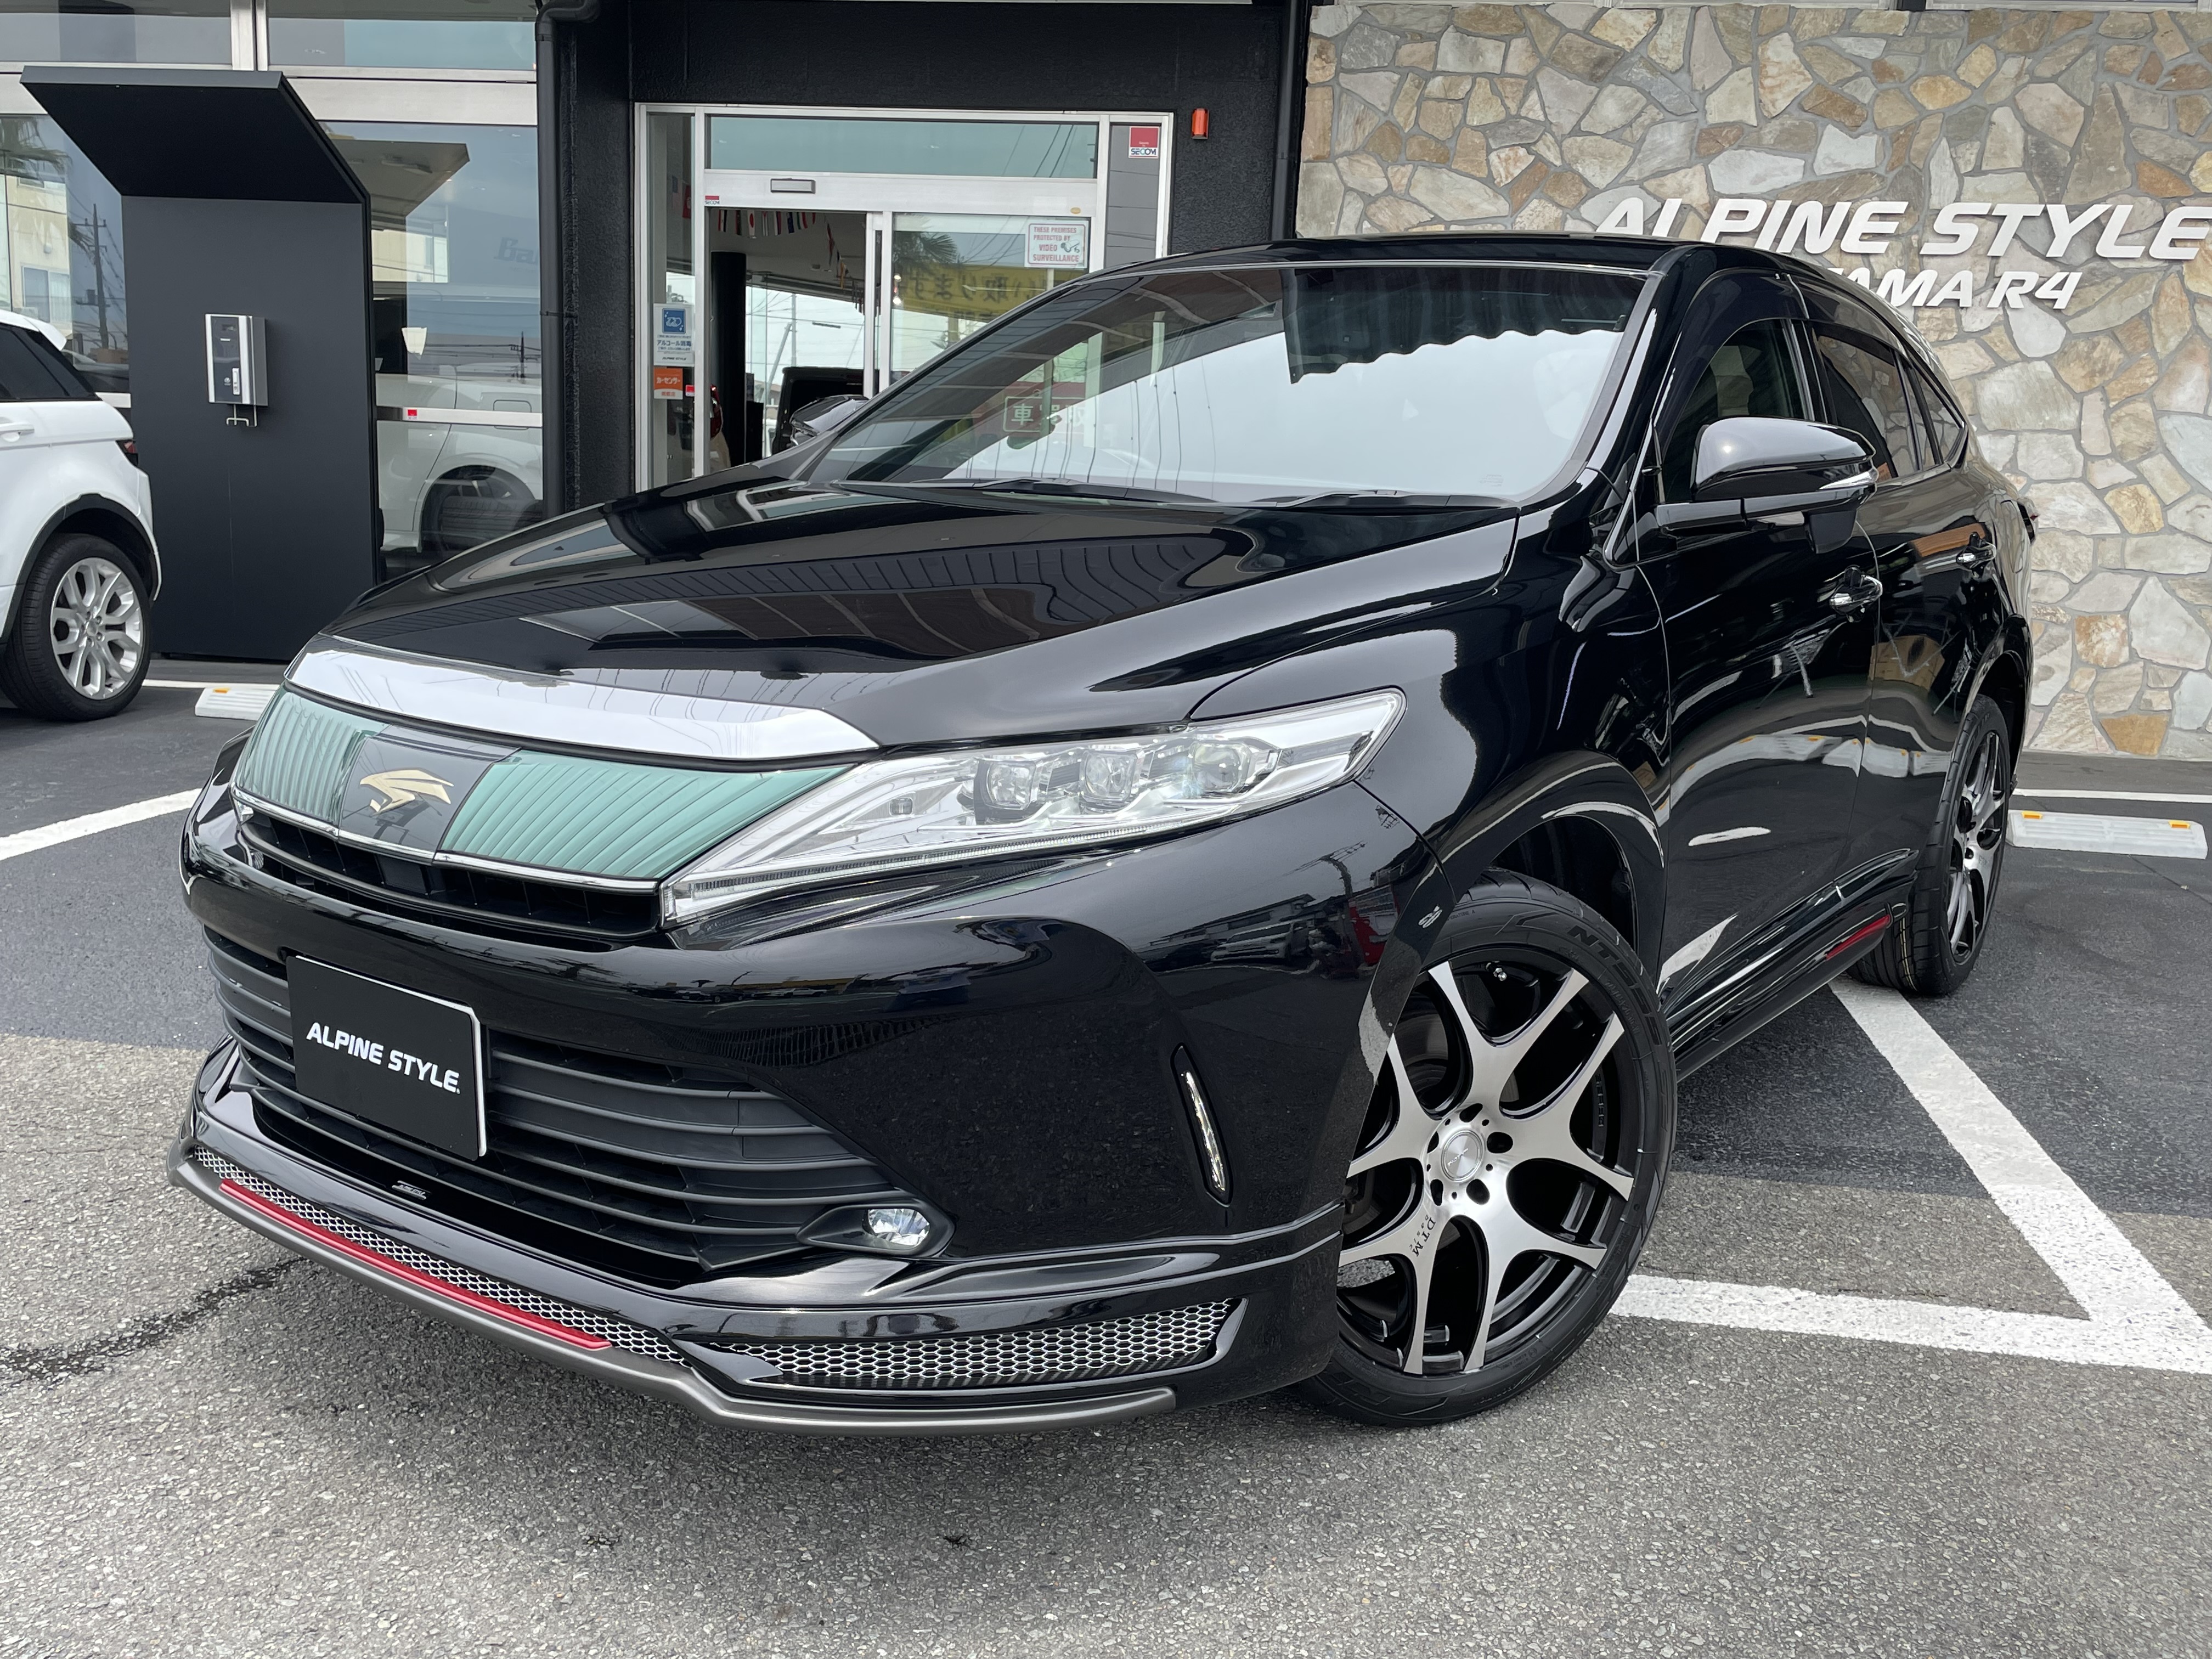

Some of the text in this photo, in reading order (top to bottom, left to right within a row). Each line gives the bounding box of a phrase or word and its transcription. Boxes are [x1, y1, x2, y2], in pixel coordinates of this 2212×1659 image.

[1596, 197, 2212, 259] ALPINE STYLE
[1829, 267, 2083, 309] AMA R4
[306, 1022, 460, 1092] ALPINE STYLE
[1412, 1217, 1436, 1257] DTM
